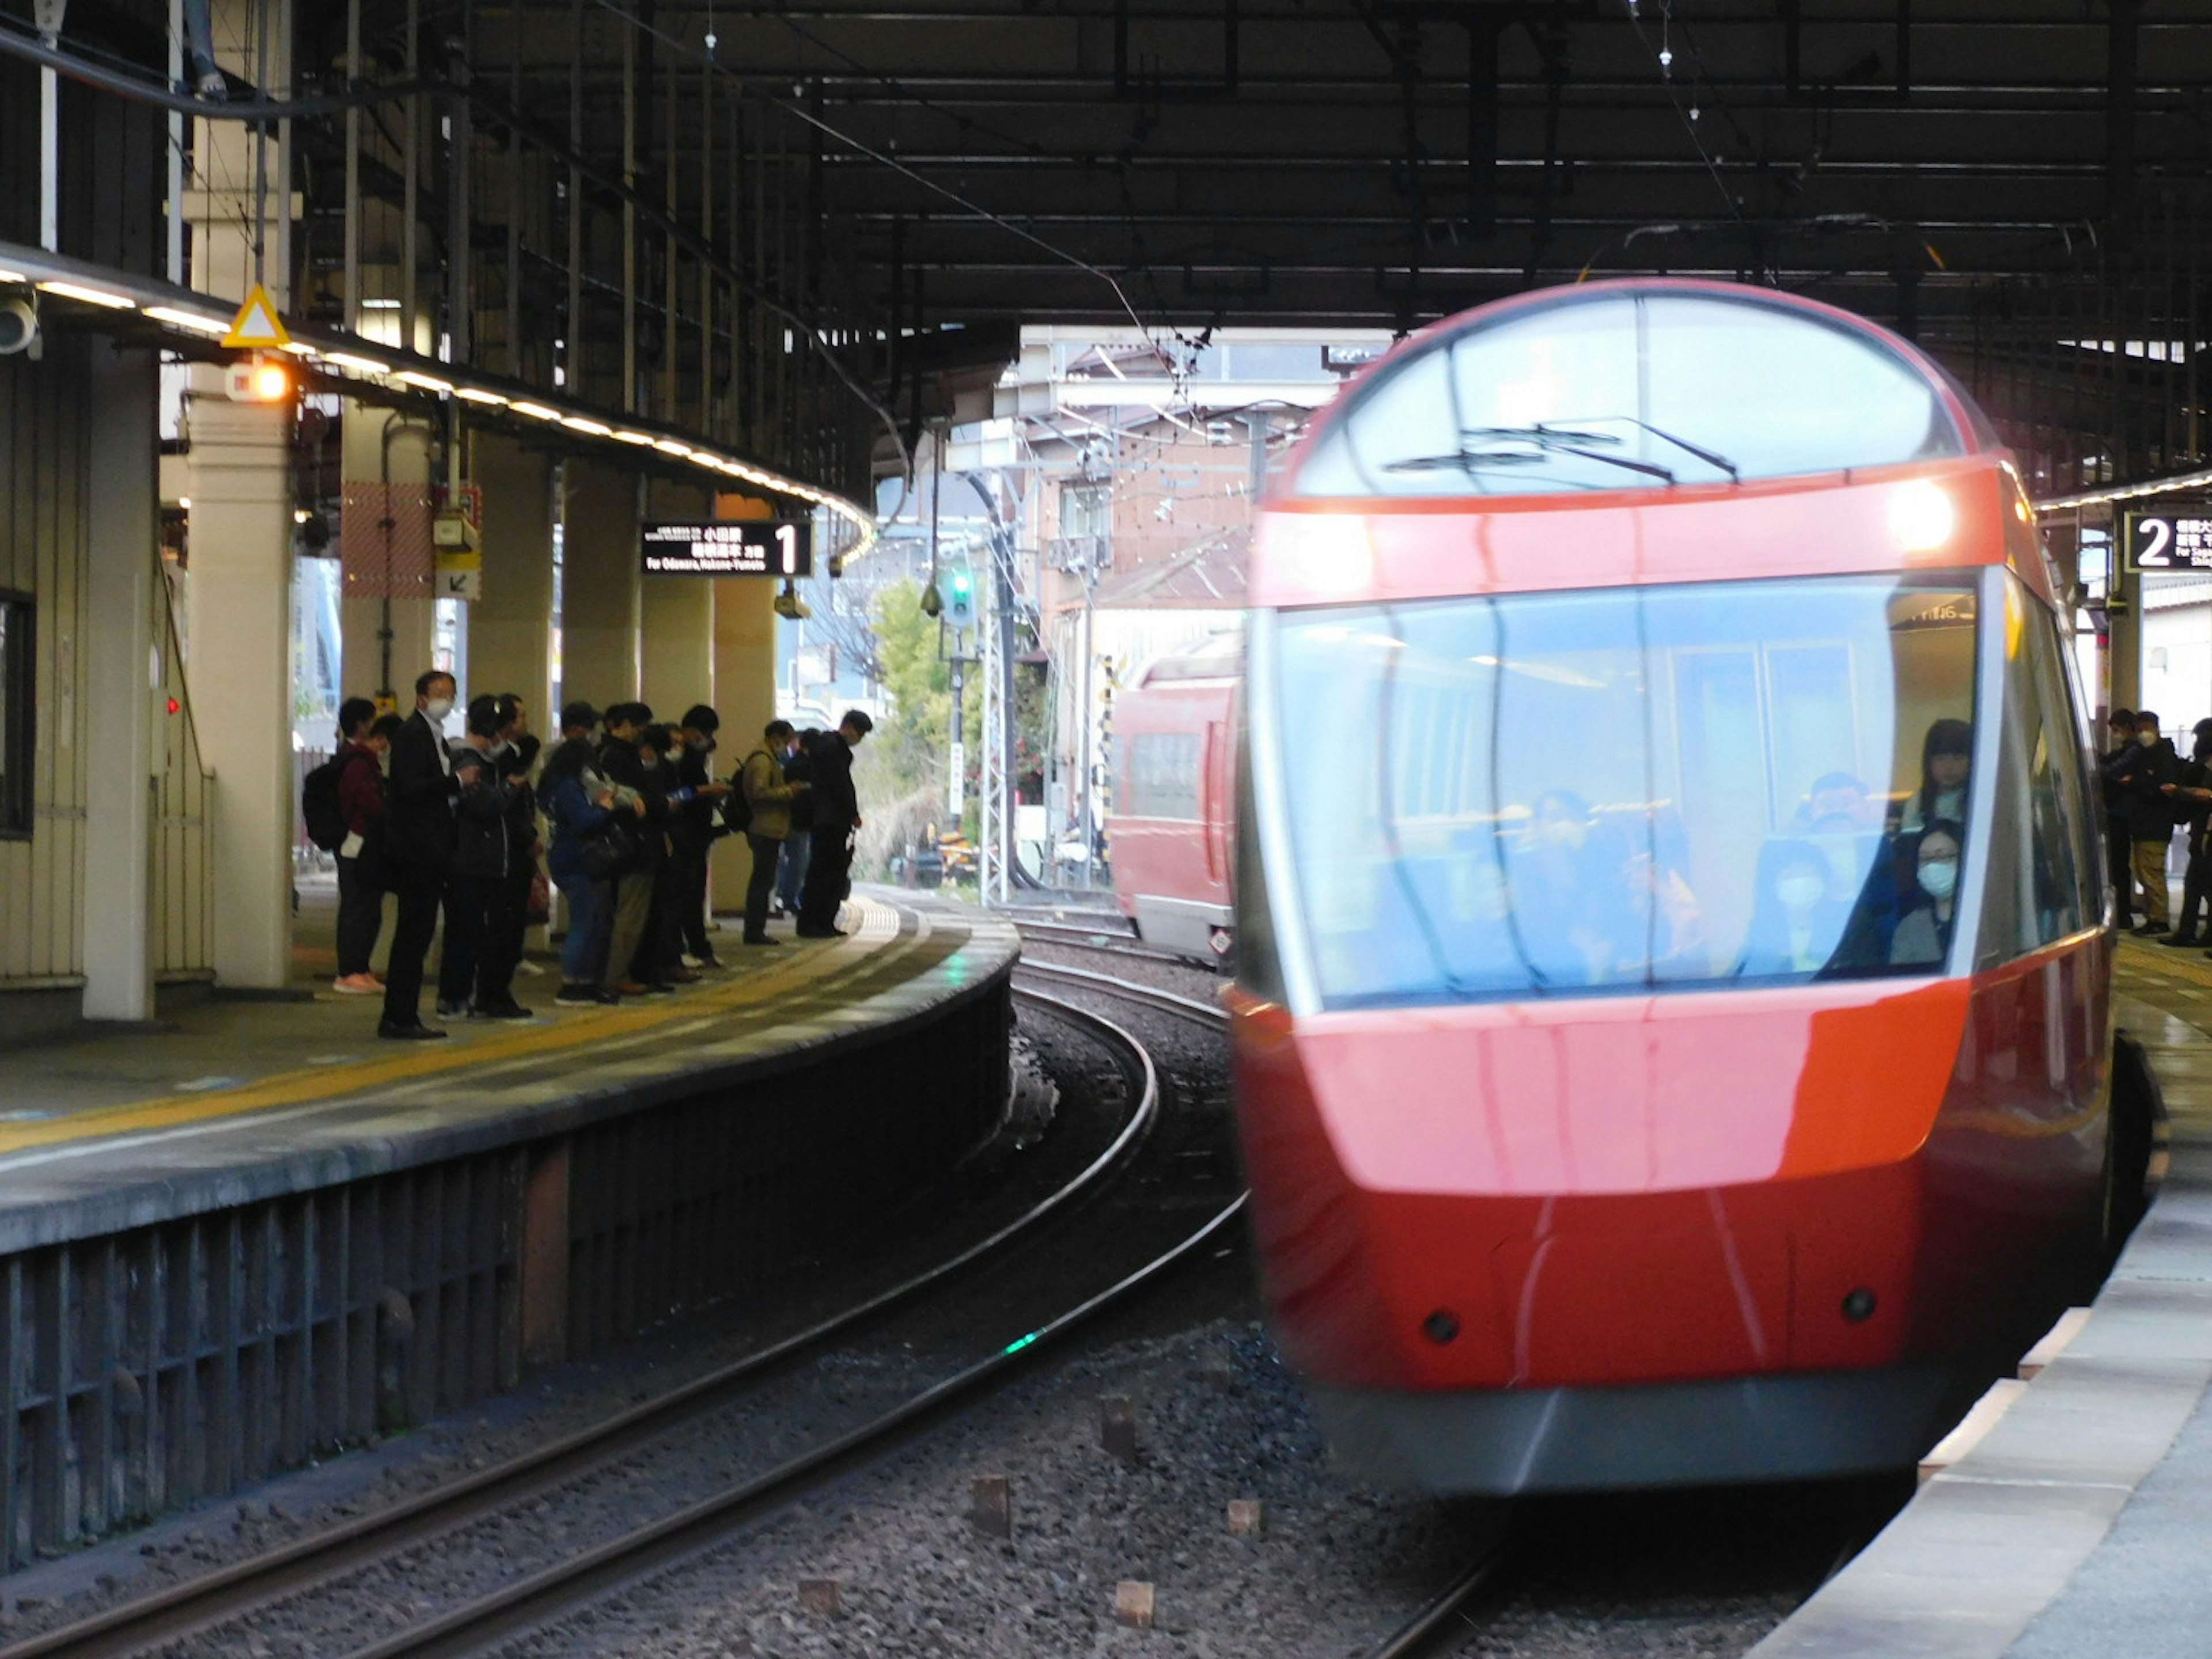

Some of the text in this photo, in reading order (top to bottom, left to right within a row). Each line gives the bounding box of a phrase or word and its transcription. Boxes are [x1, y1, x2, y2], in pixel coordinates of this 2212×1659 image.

[647, 558, 661, 569] For
[775, 524, 796, 574] 1
[2138, 519, 2170, 566] 2
